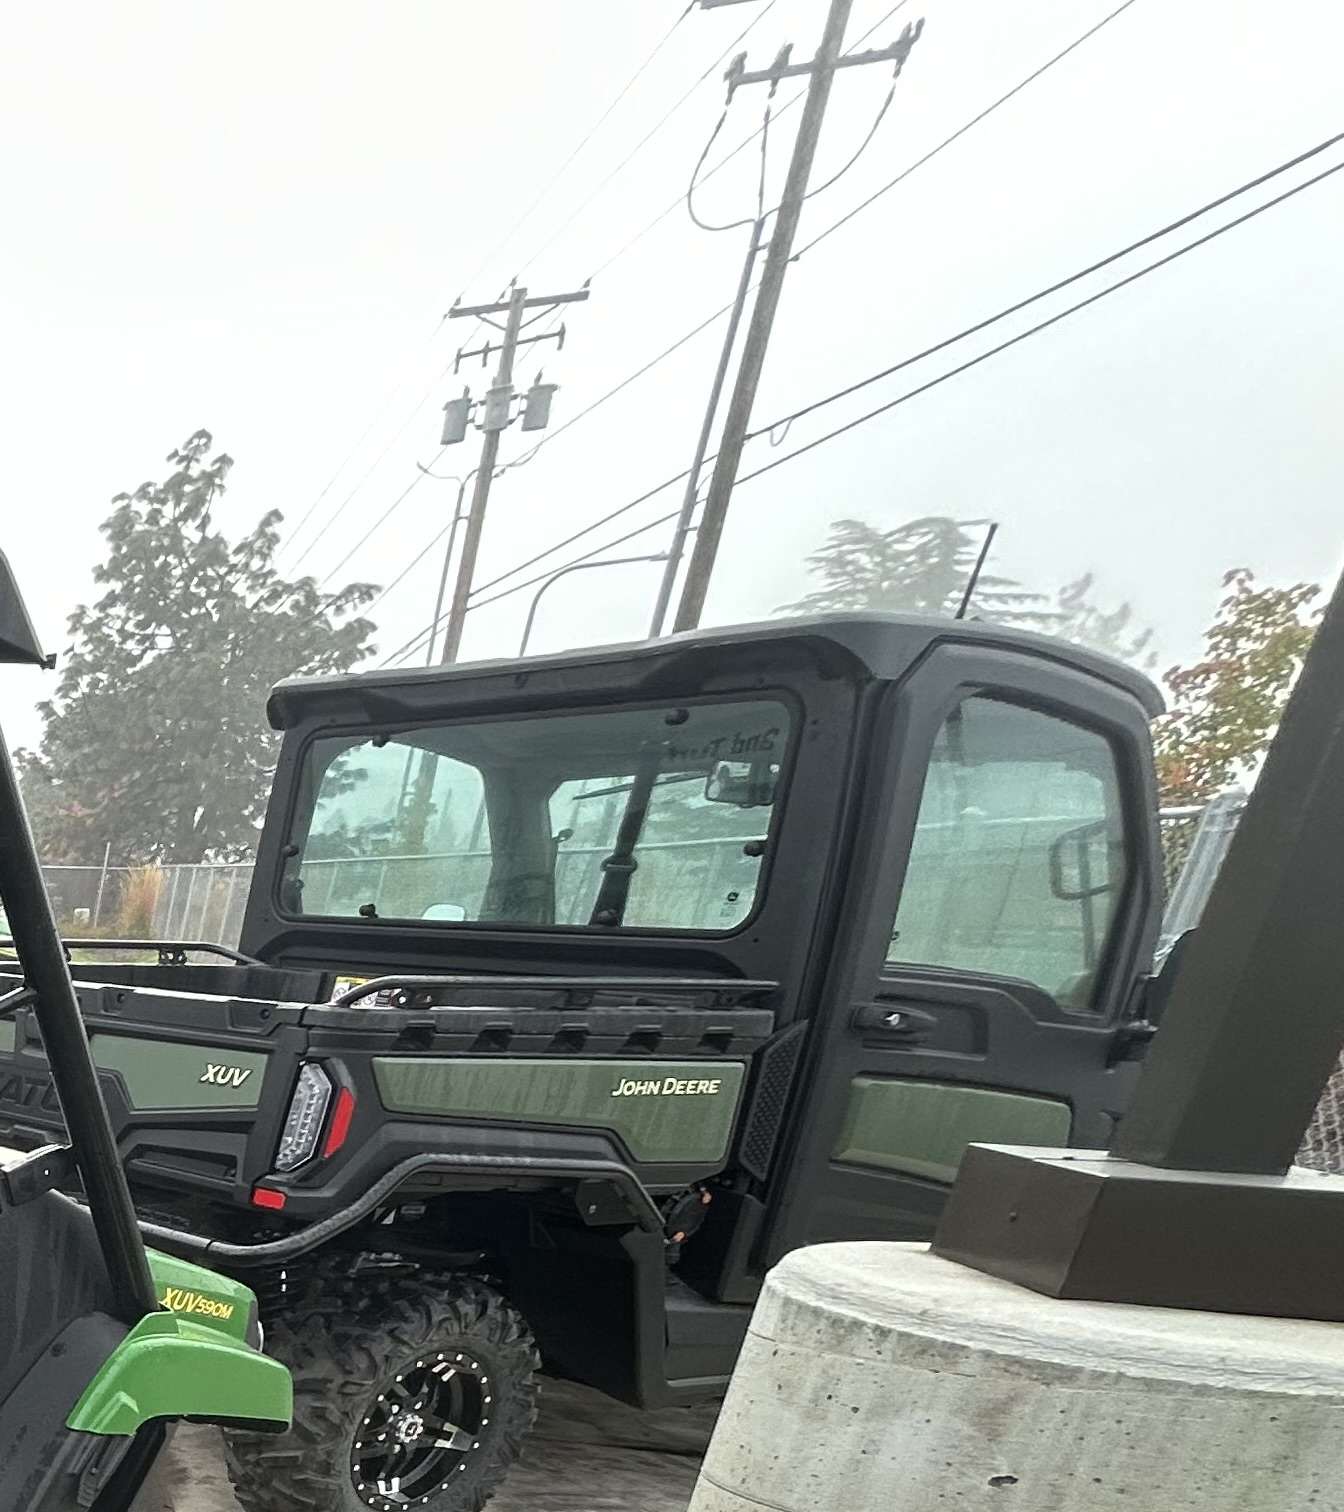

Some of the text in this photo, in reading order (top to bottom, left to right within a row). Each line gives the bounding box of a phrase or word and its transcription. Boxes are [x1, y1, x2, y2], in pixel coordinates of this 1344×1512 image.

[201, 1063, 252, 1088] XUV
[612, 1077, 722, 1097] JOHN DEERE
[161, 1287, 234, 1320] XUV590M
